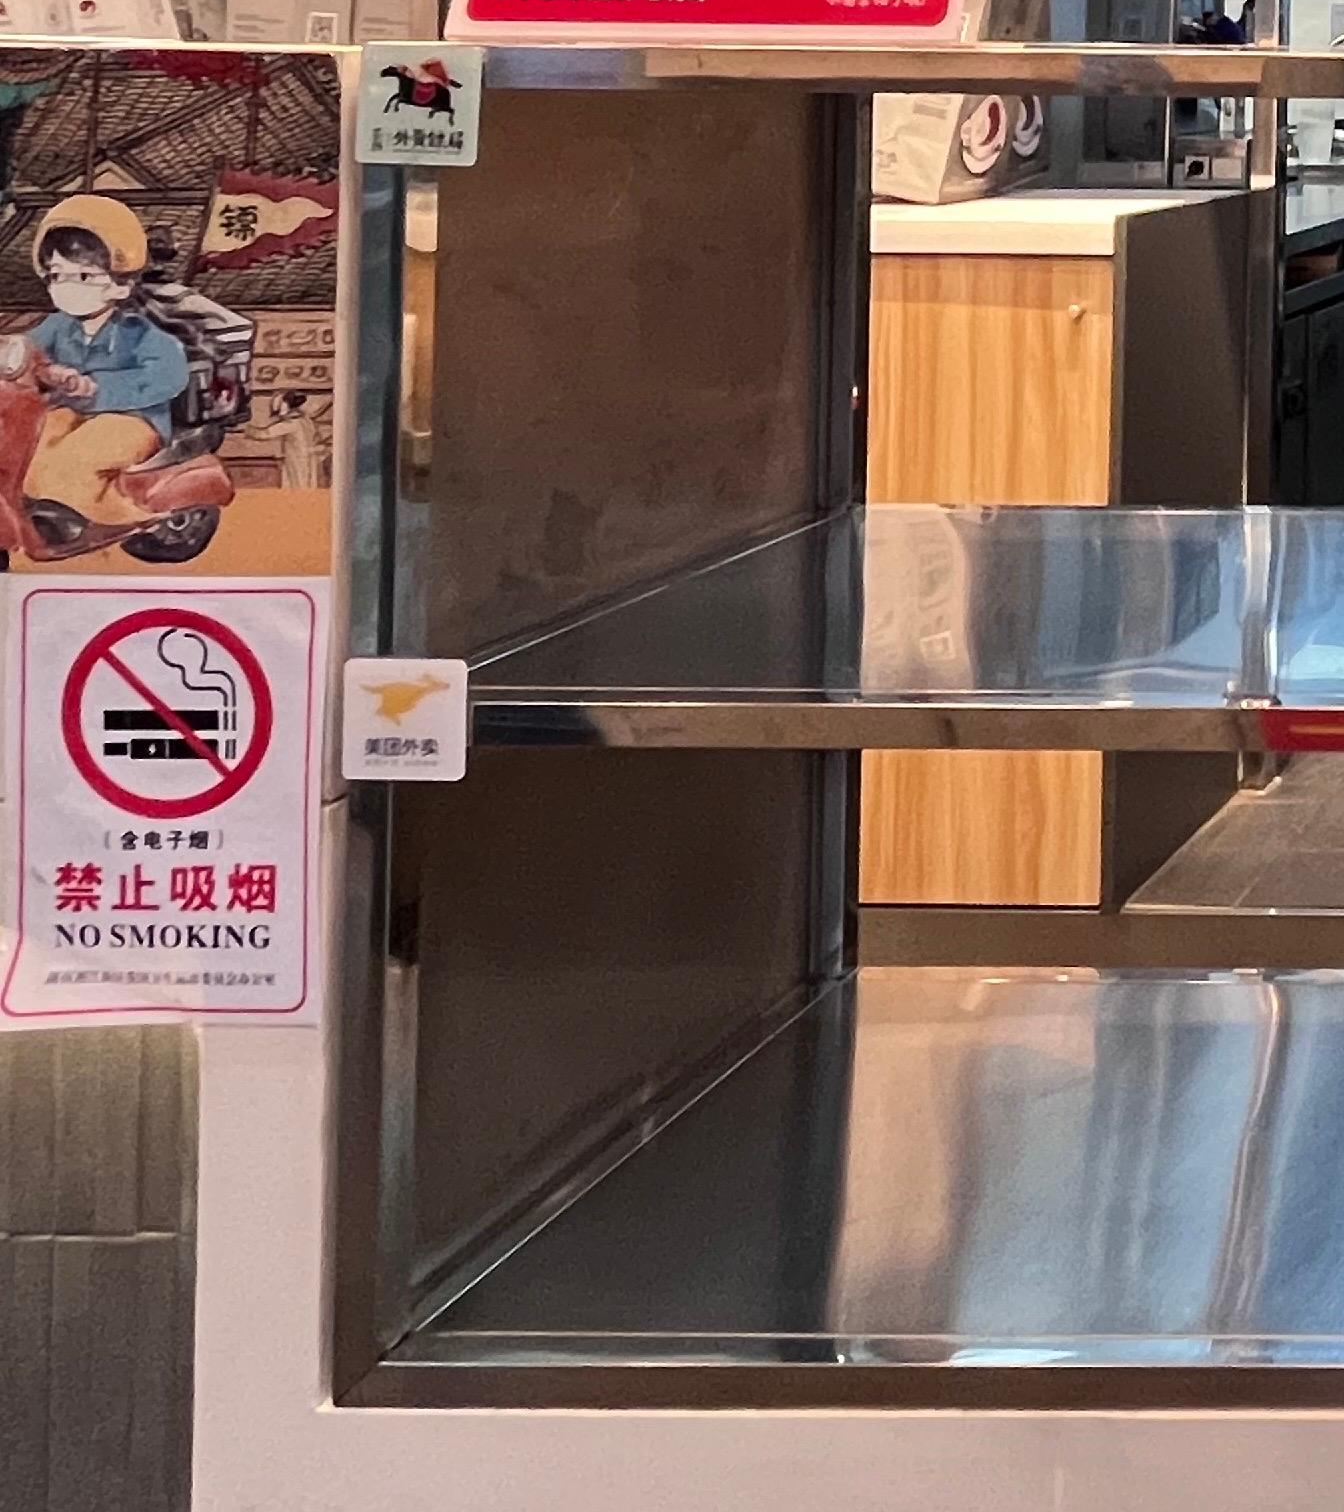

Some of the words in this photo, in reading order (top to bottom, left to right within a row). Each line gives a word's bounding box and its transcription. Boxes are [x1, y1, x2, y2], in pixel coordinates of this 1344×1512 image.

[54, 862, 278, 914] 禁止吸烟
[54, 924, 101, 949] NO
[109, 924, 271, 949] SMOKING
